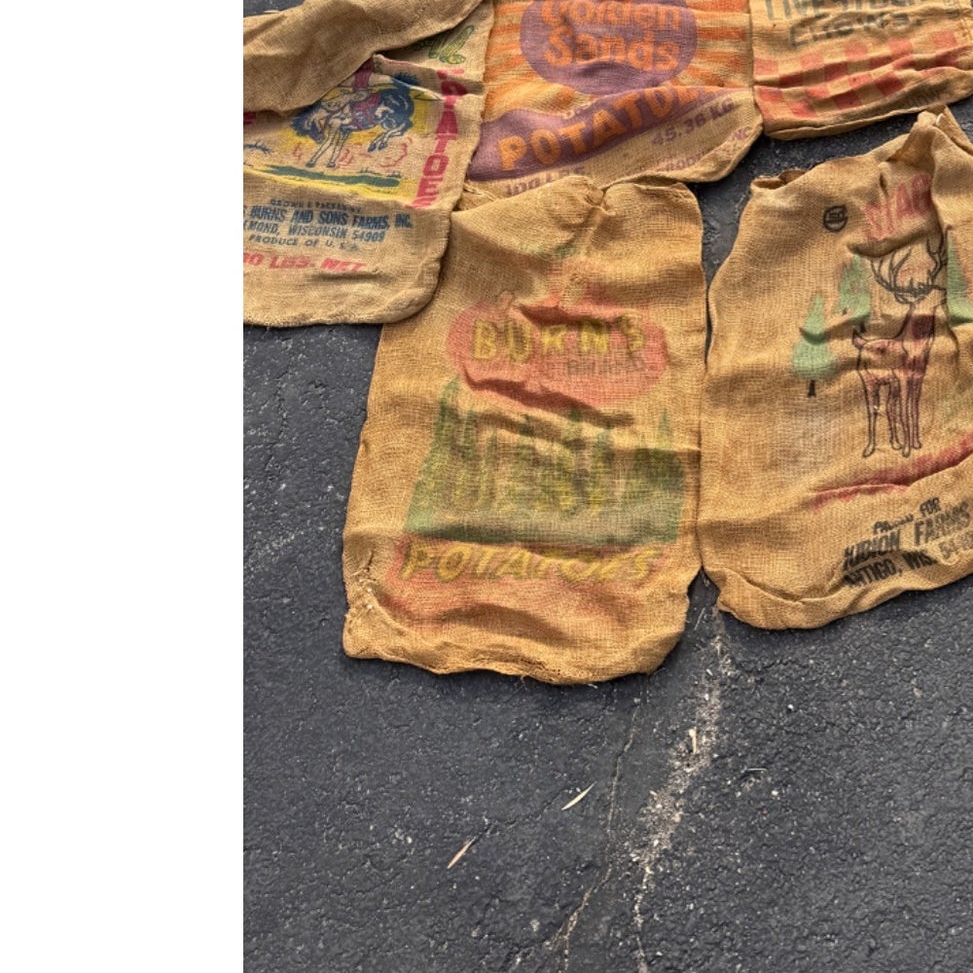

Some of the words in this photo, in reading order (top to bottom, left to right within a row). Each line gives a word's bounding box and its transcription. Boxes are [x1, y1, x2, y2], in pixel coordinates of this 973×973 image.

[544, 25, 682, 73] Sands
[250, 205, 288, 223] BURNS
[291, 209, 314, 224] AND
[317, 210, 350, 226] SONS
[248, 234, 298, 247] PRODUCE
[287, 224, 347, 239] WISCONSIN
[919, 496, 942, 517] FOR
